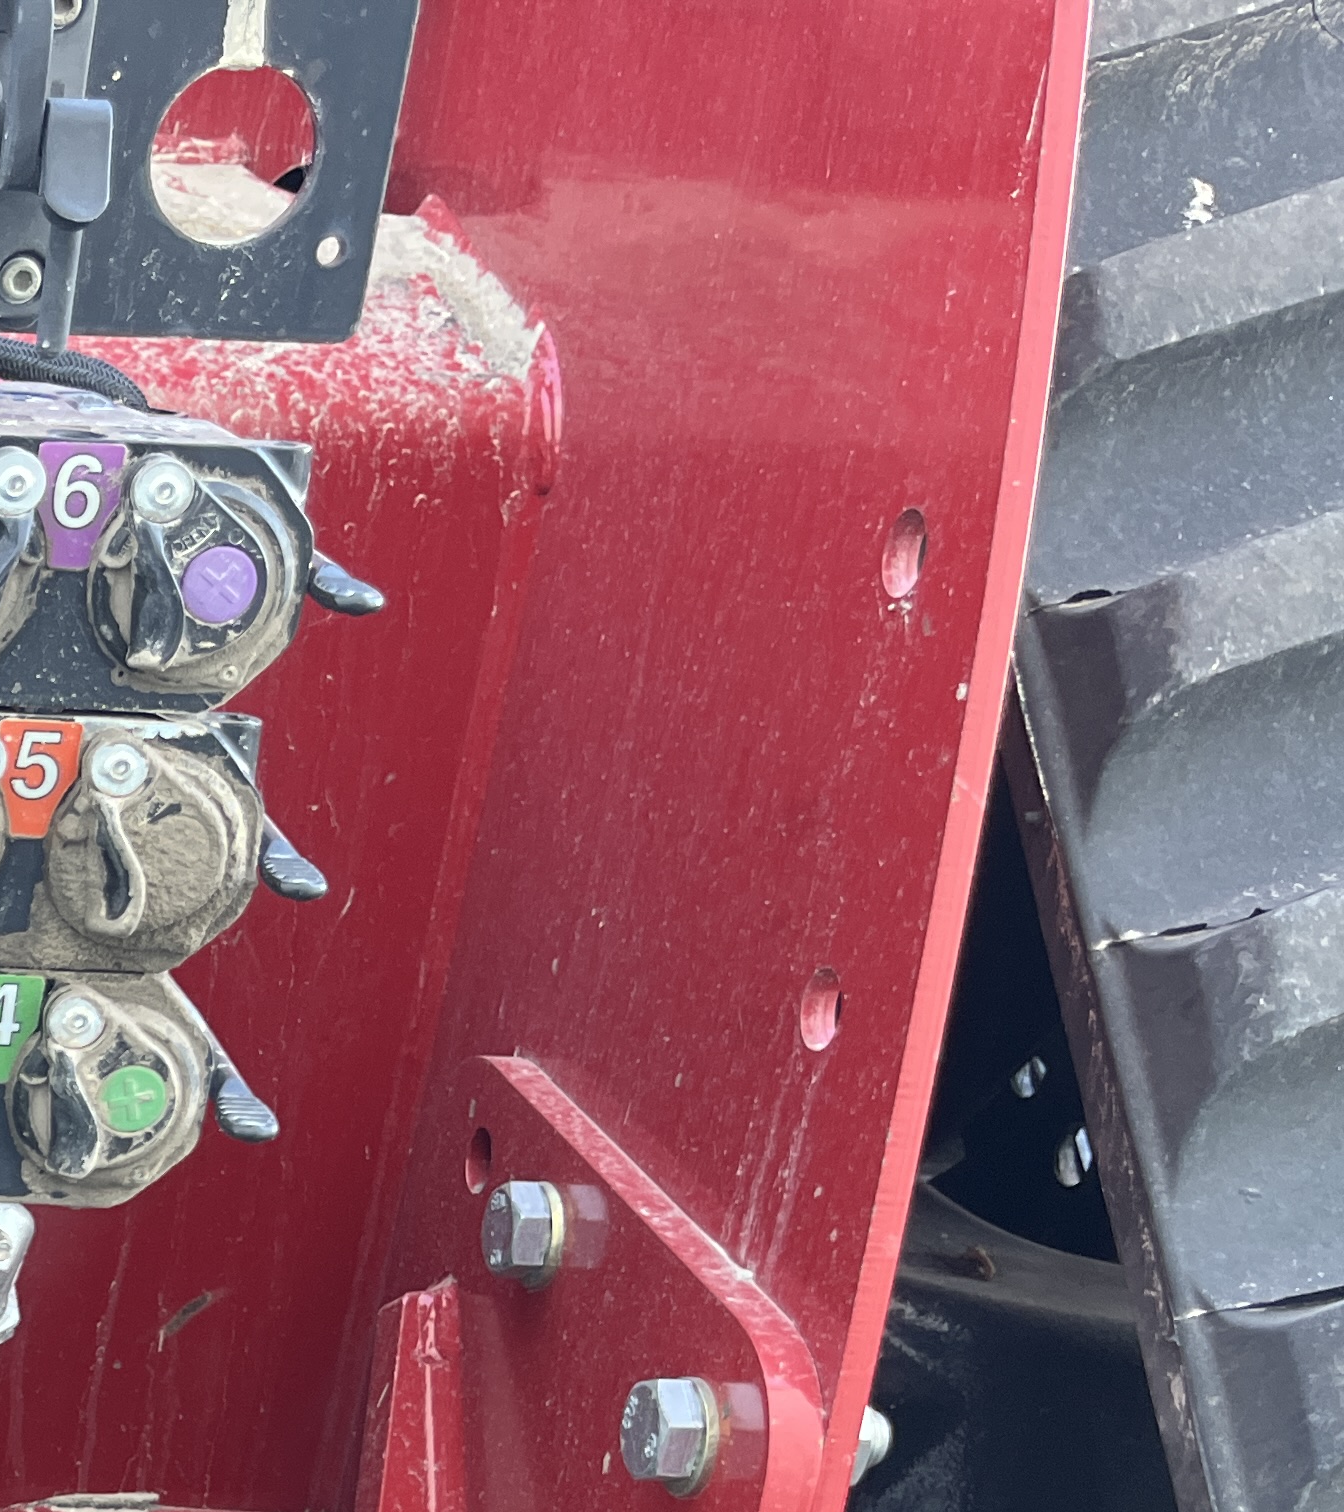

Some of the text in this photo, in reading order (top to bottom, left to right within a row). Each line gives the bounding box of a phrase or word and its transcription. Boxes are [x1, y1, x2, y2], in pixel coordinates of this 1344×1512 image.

[53, 454, 103, 529] 6
[171, 519, 211, 554] OPEN
[11, 730, 62, 800] 5
